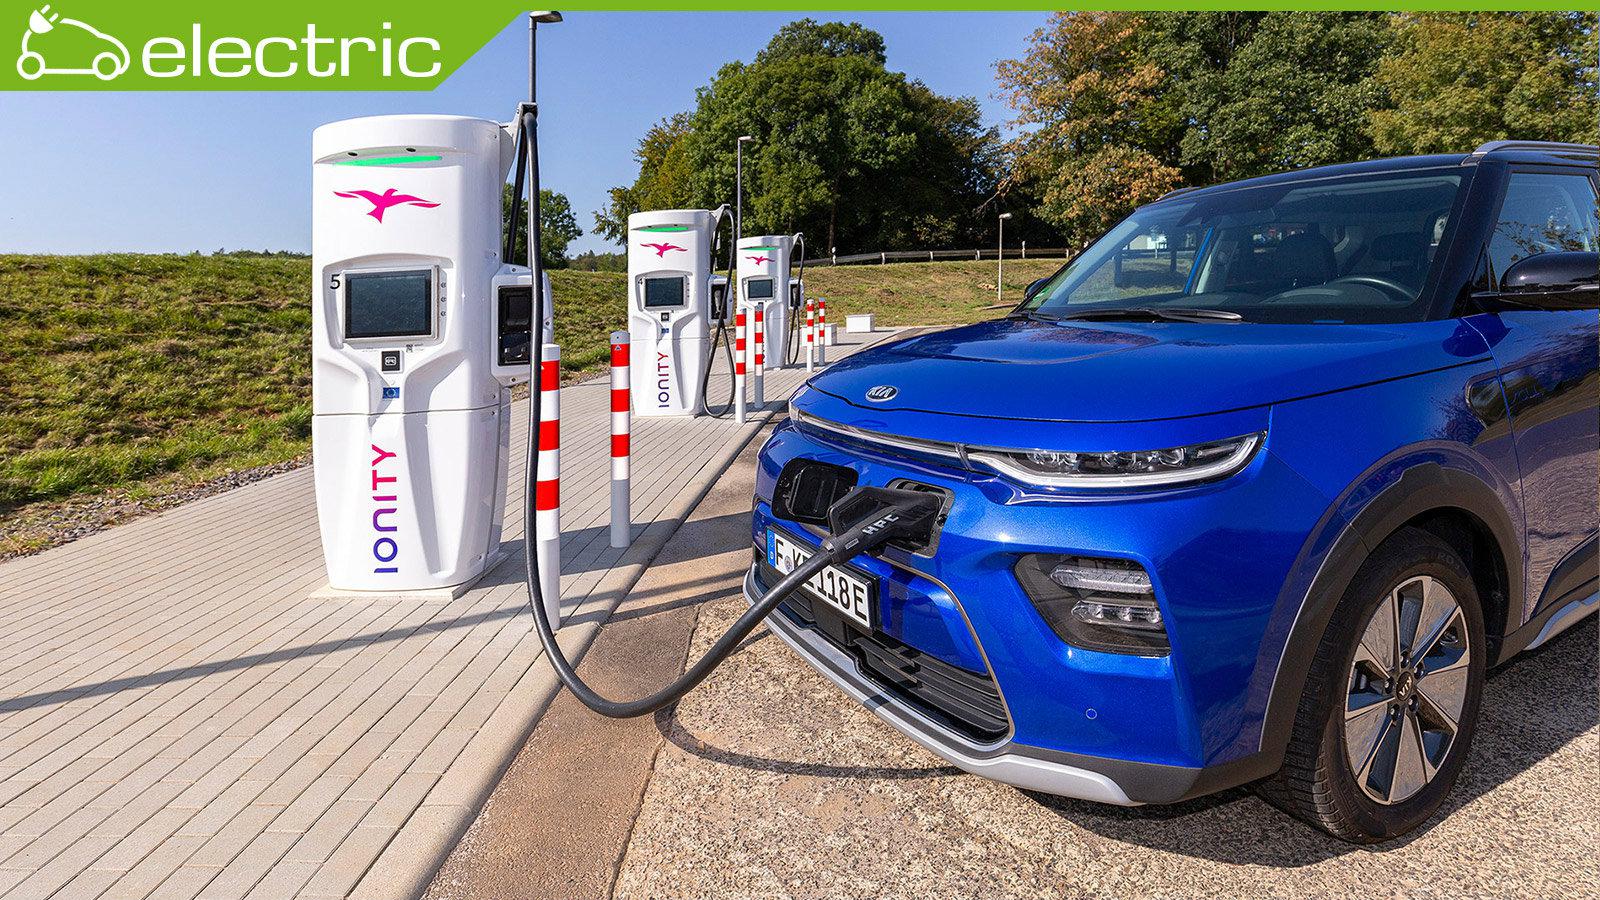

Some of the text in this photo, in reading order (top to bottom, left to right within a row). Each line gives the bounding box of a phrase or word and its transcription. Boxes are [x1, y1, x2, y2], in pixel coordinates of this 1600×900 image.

[330, 274, 340, 289] 5
[658, 352, 669, 407] IONITY
[868, 386, 893, 398] KIA
[372, 444, 398, 573] IONITY
[862, 514, 899, 535] HPC
